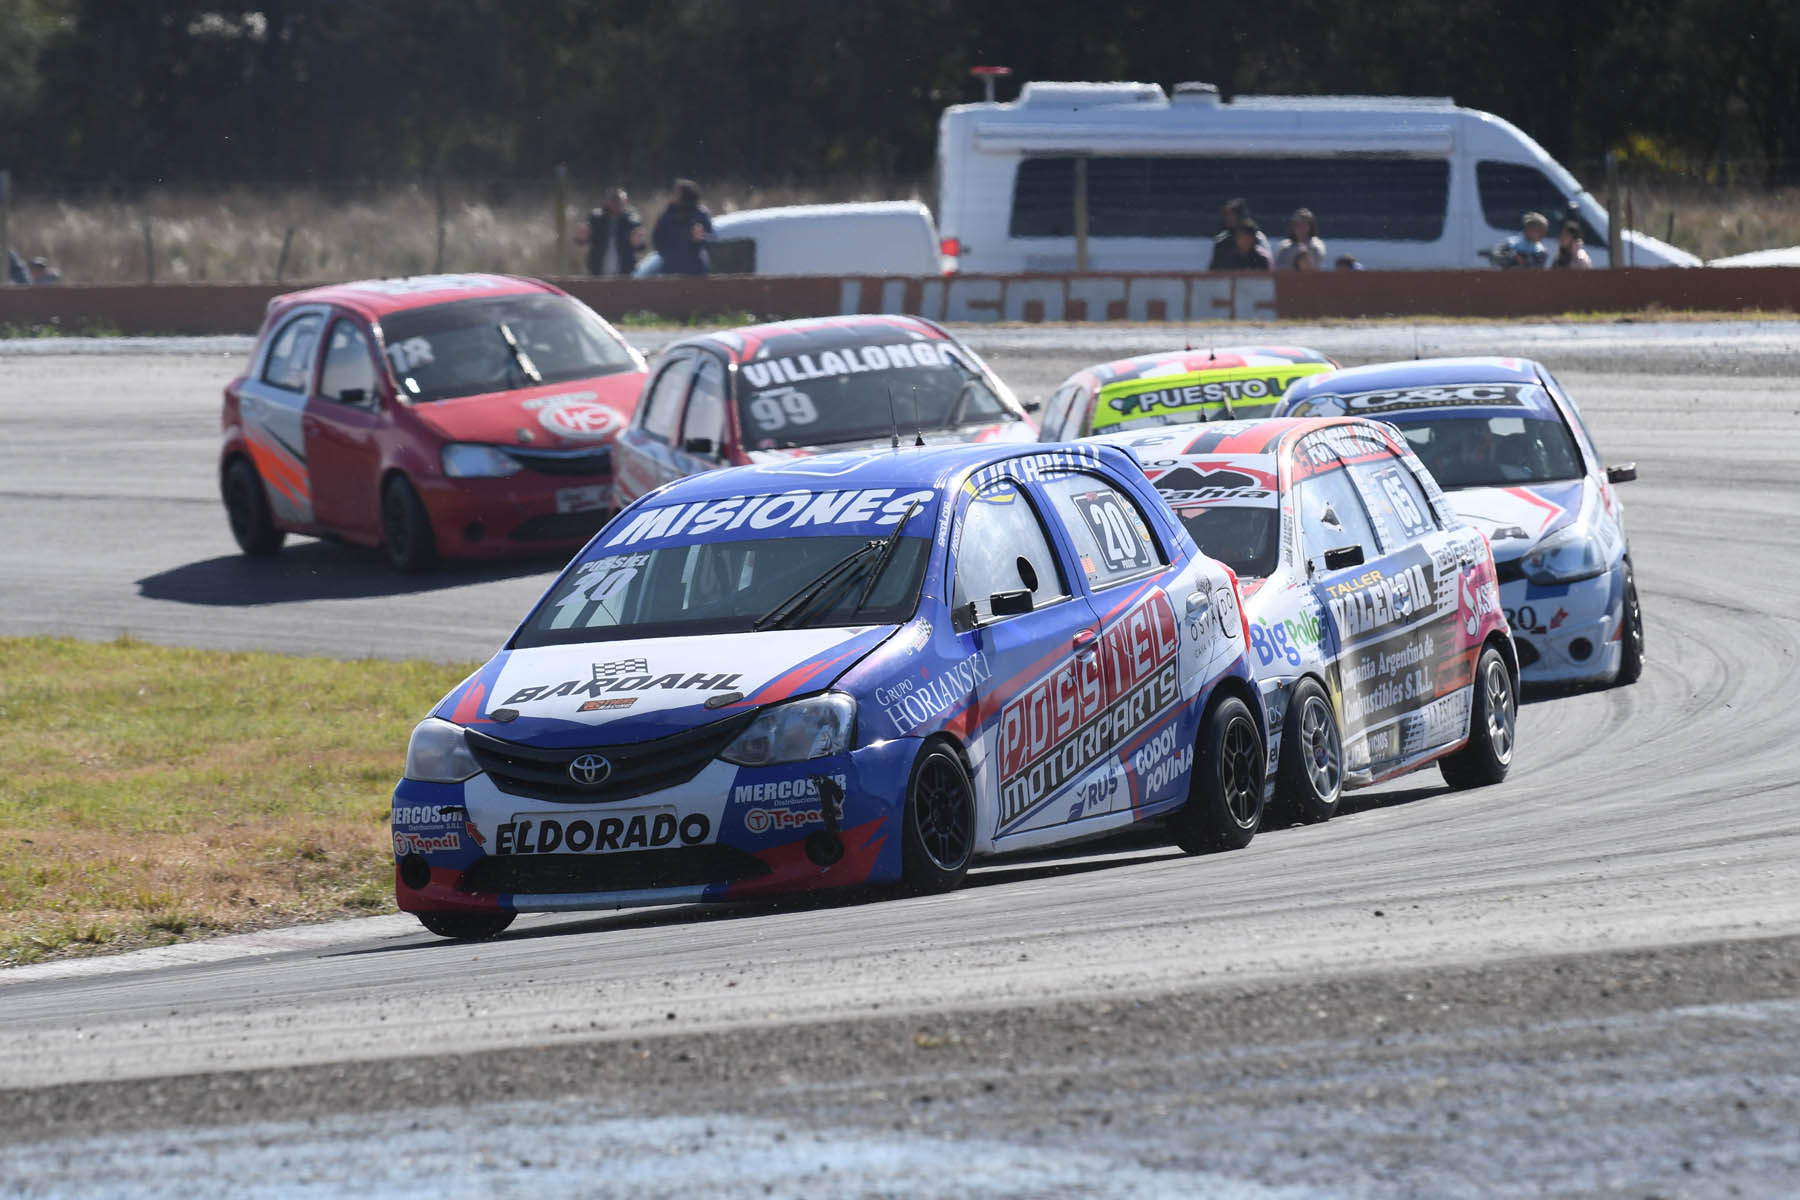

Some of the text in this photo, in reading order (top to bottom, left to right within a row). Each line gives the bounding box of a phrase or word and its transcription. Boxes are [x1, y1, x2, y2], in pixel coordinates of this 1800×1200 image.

[752, 388, 818, 431] 99
[1350, 385, 1505, 409] C&C
[604, 488, 935, 549] MISIONES
[1090, 502, 1136, 560] 20
[555, 568, 638, 607] 20
[1327, 569, 1385, 599] TALLER
[1250, 617, 1301, 666] Big
[1284, 609, 1322, 649] Pollo
[1379, 642, 1424, 677] Argentina
[1424, 634, 1433, 656] de
[501, 672, 744, 706] BARDAHL
[875, 679, 913, 706] GRUPO
[884, 650, 992, 735] HORIANSKI
[1003, 595, 1178, 776] POSSIEL
[1004, 670, 1176, 822] MOTORPARTS
[1135, 723, 1178, 776] GODOY
[735, 774, 847, 803] MERCOSR
[1088, 771, 1118, 808] RUS
[496, 813, 710, 855] ELDORADO
